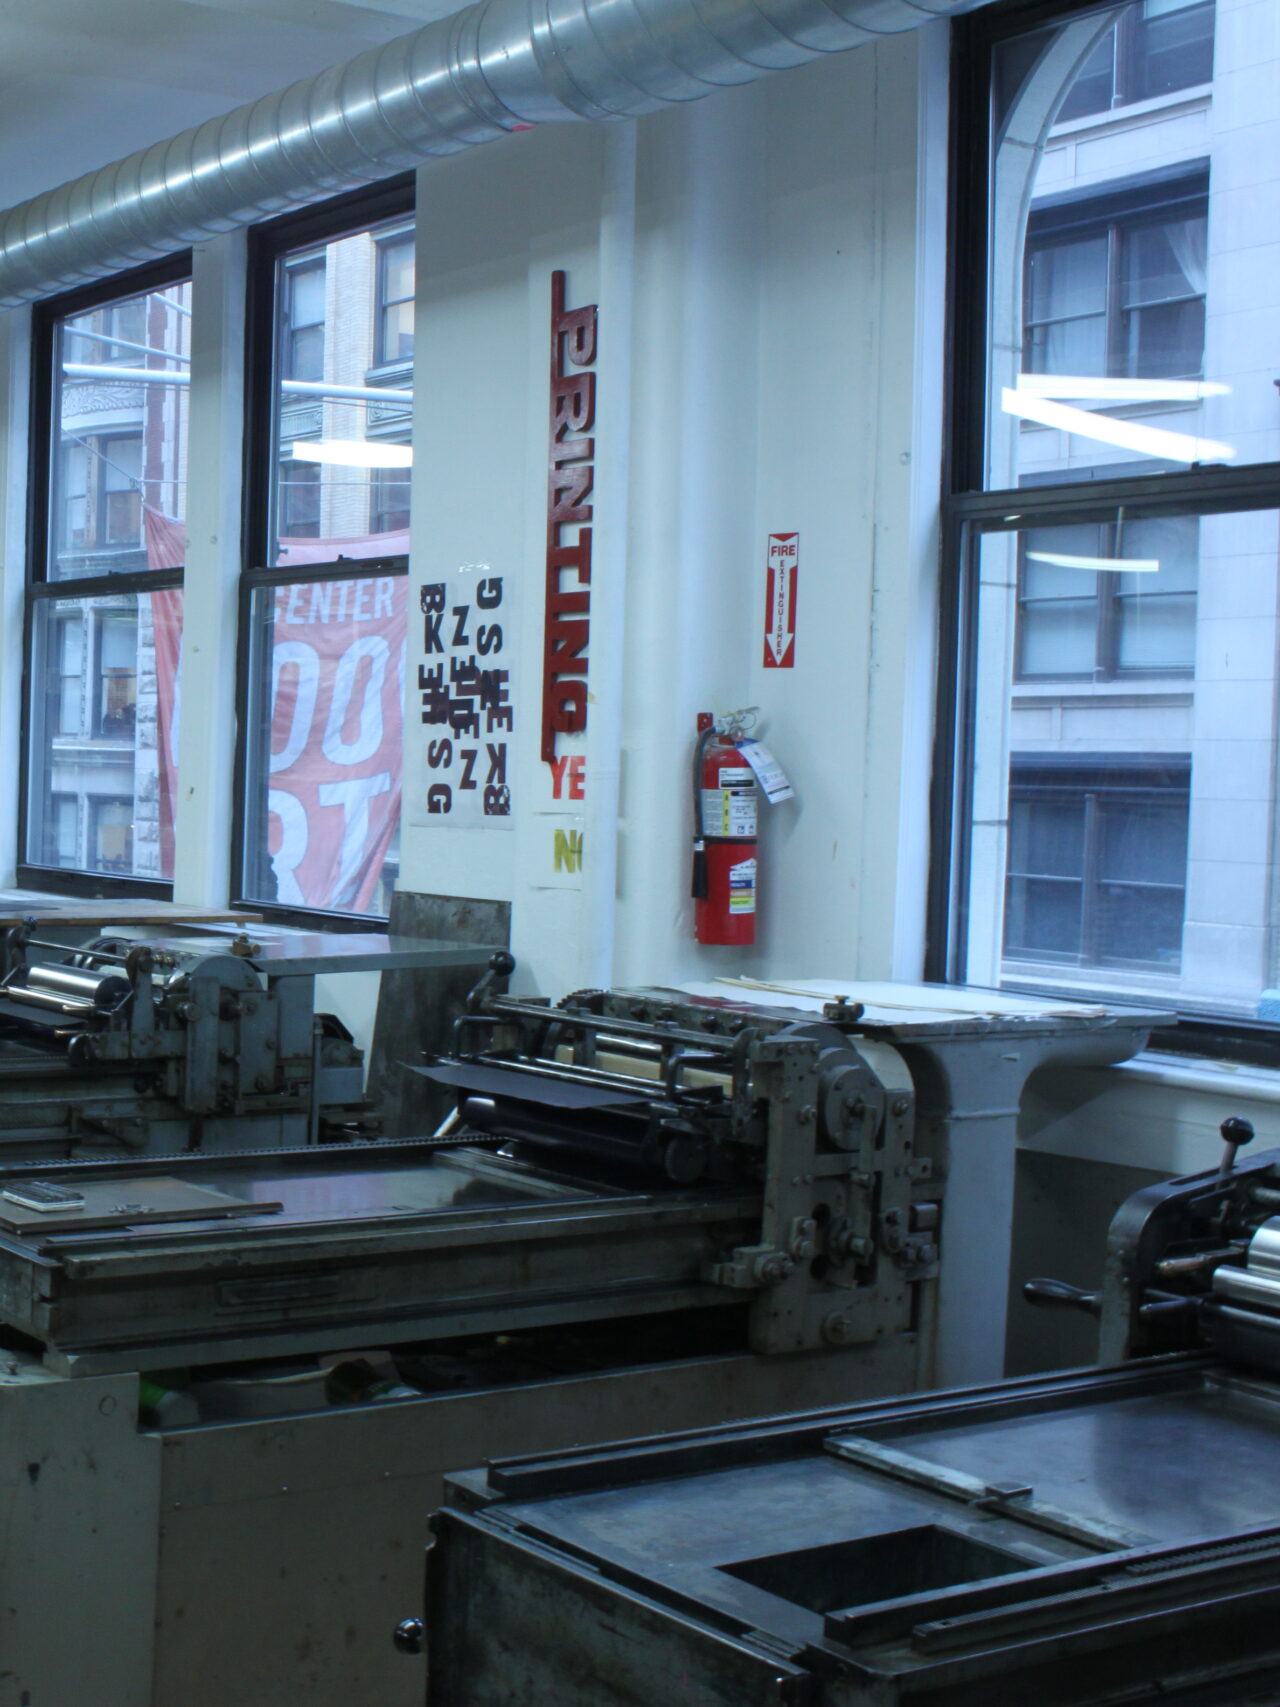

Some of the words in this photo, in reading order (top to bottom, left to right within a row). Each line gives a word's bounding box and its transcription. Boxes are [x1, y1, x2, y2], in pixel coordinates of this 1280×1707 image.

[543, 296, 598, 738] PRINTING
[771, 544, 796, 557] FIRE
[776, 559, 785, 656] EXTINGUISHER
